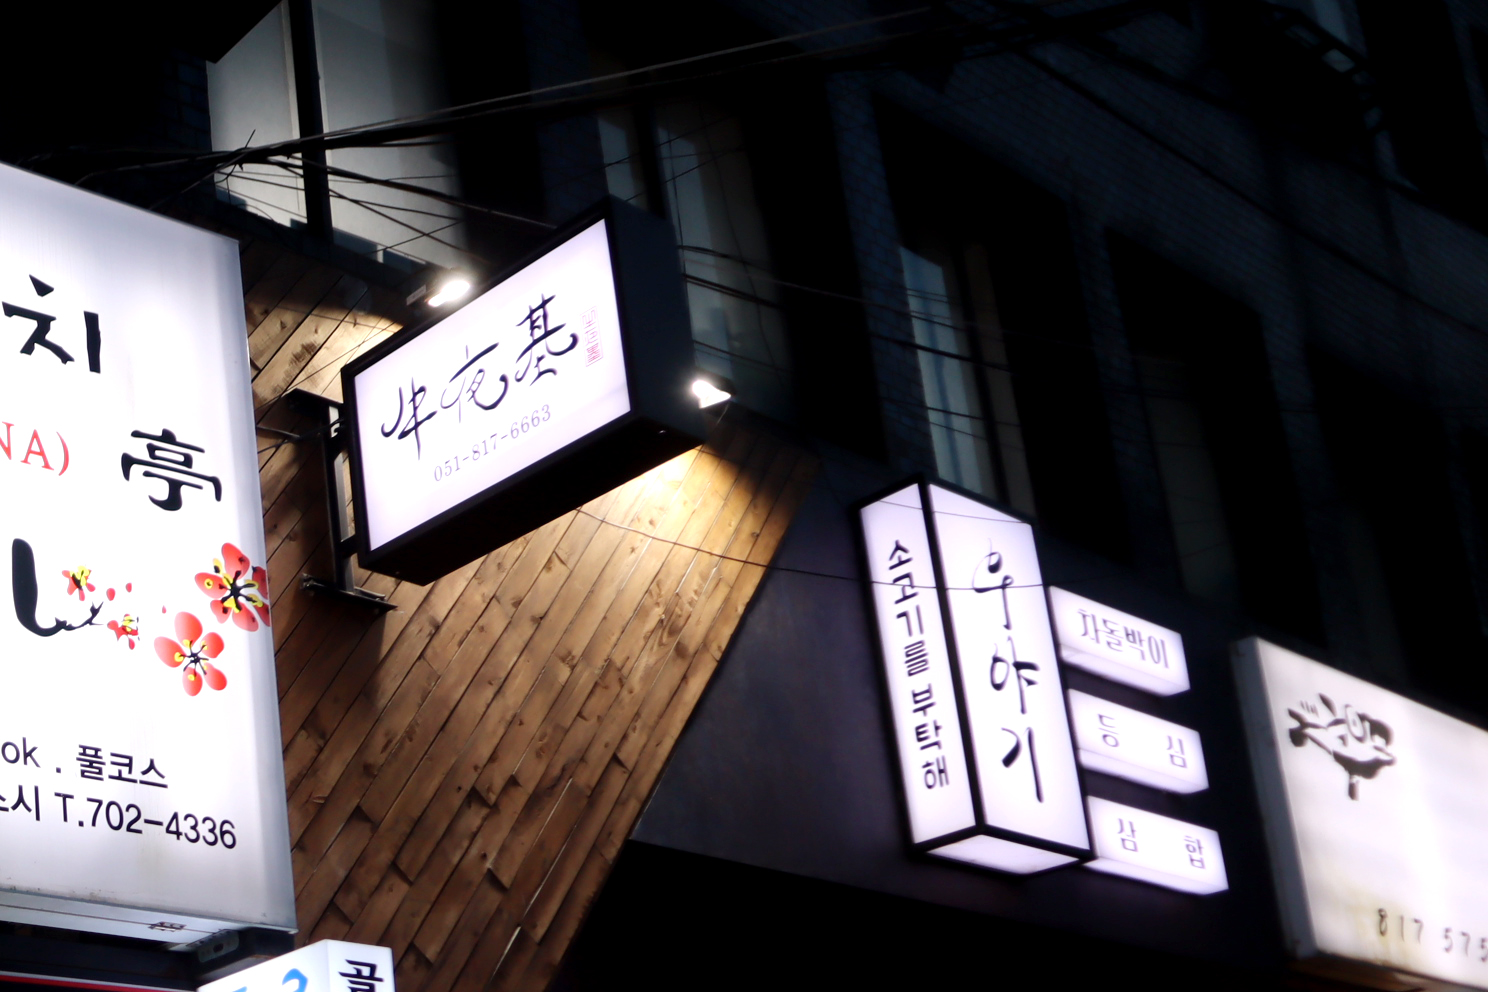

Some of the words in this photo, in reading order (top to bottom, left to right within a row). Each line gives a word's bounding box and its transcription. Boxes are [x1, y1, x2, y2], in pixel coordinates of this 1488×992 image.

[433, 404, 552, 482] 051-817-6663
[1077, 608, 1169, 669] 차돌박이
[74, 743, 169, 788] 풀코스
[55, 791, 237, 850] T.702-4336
[1378, 908, 1424, 943] 817
